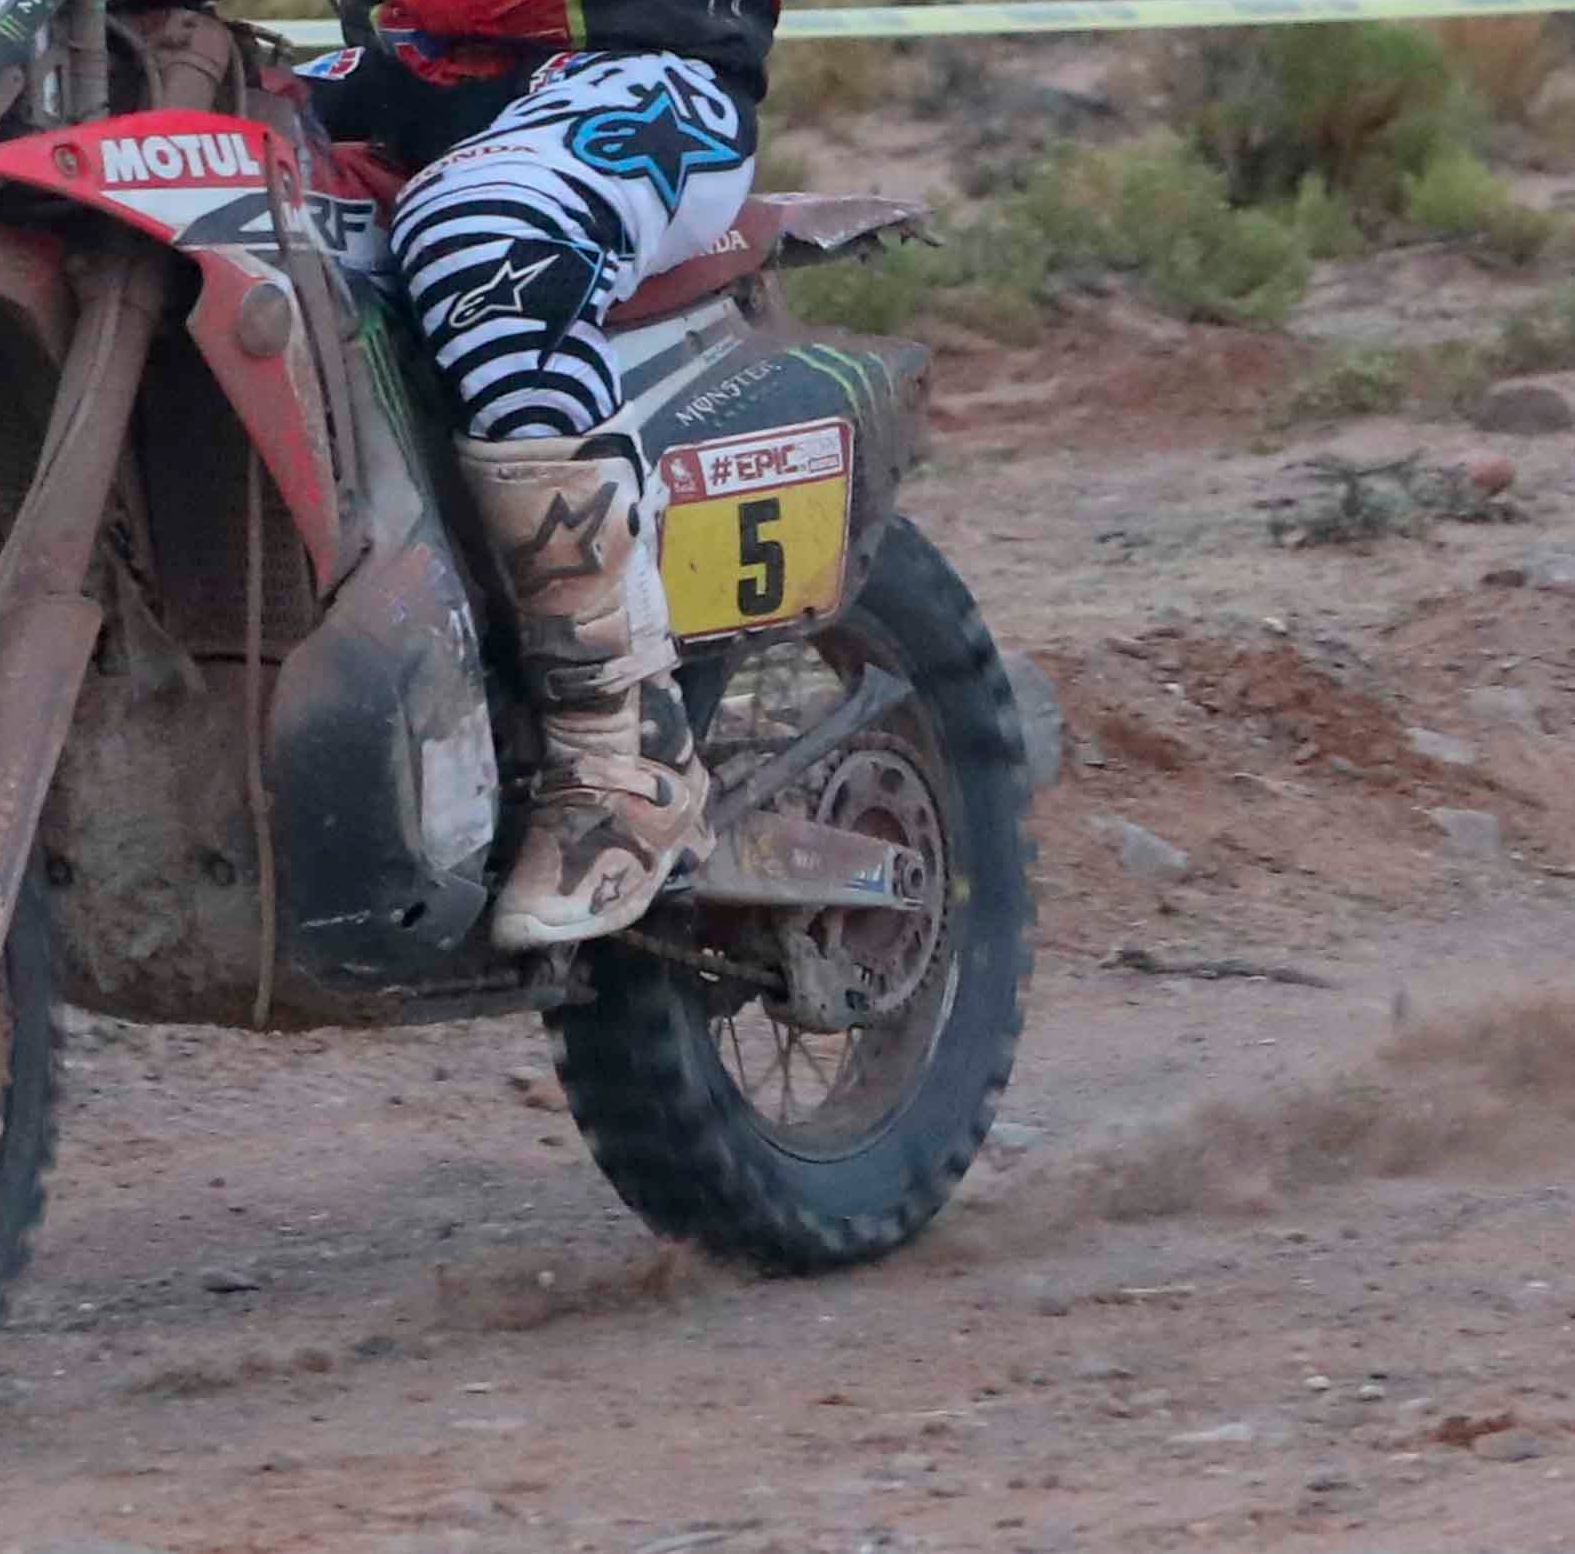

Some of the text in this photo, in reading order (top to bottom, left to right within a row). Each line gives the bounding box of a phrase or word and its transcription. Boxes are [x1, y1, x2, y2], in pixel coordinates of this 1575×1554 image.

[101, 133, 261, 183] MOTUL
[674, 358, 782, 427] MONSTER
[710, 444, 798, 487] #EPIC
[737, 497, 786, 616] 5
